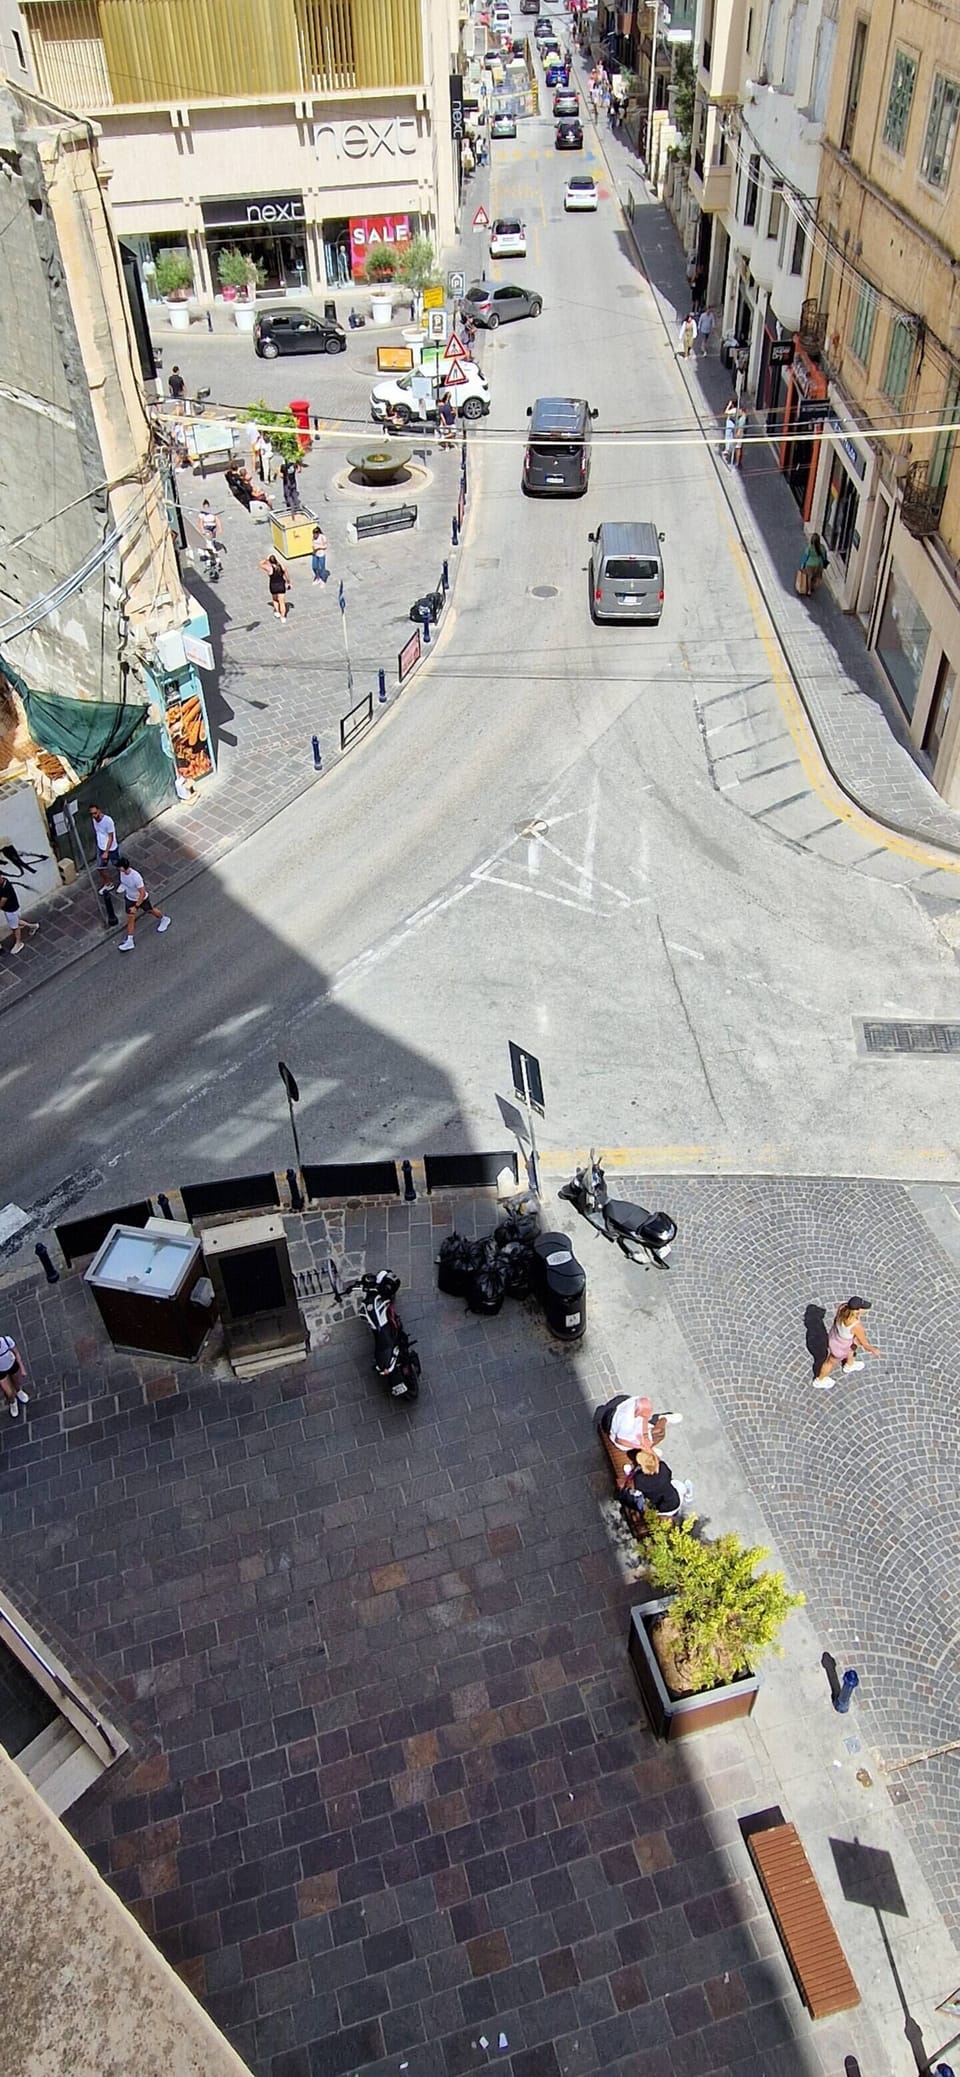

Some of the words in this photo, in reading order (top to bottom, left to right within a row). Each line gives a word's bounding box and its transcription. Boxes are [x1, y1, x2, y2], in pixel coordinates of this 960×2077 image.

[452, 100, 463, 139] next
[313, 115, 417, 161] next
[246, 201, 306, 223] next
[353, 224, 409, 245] SALE
